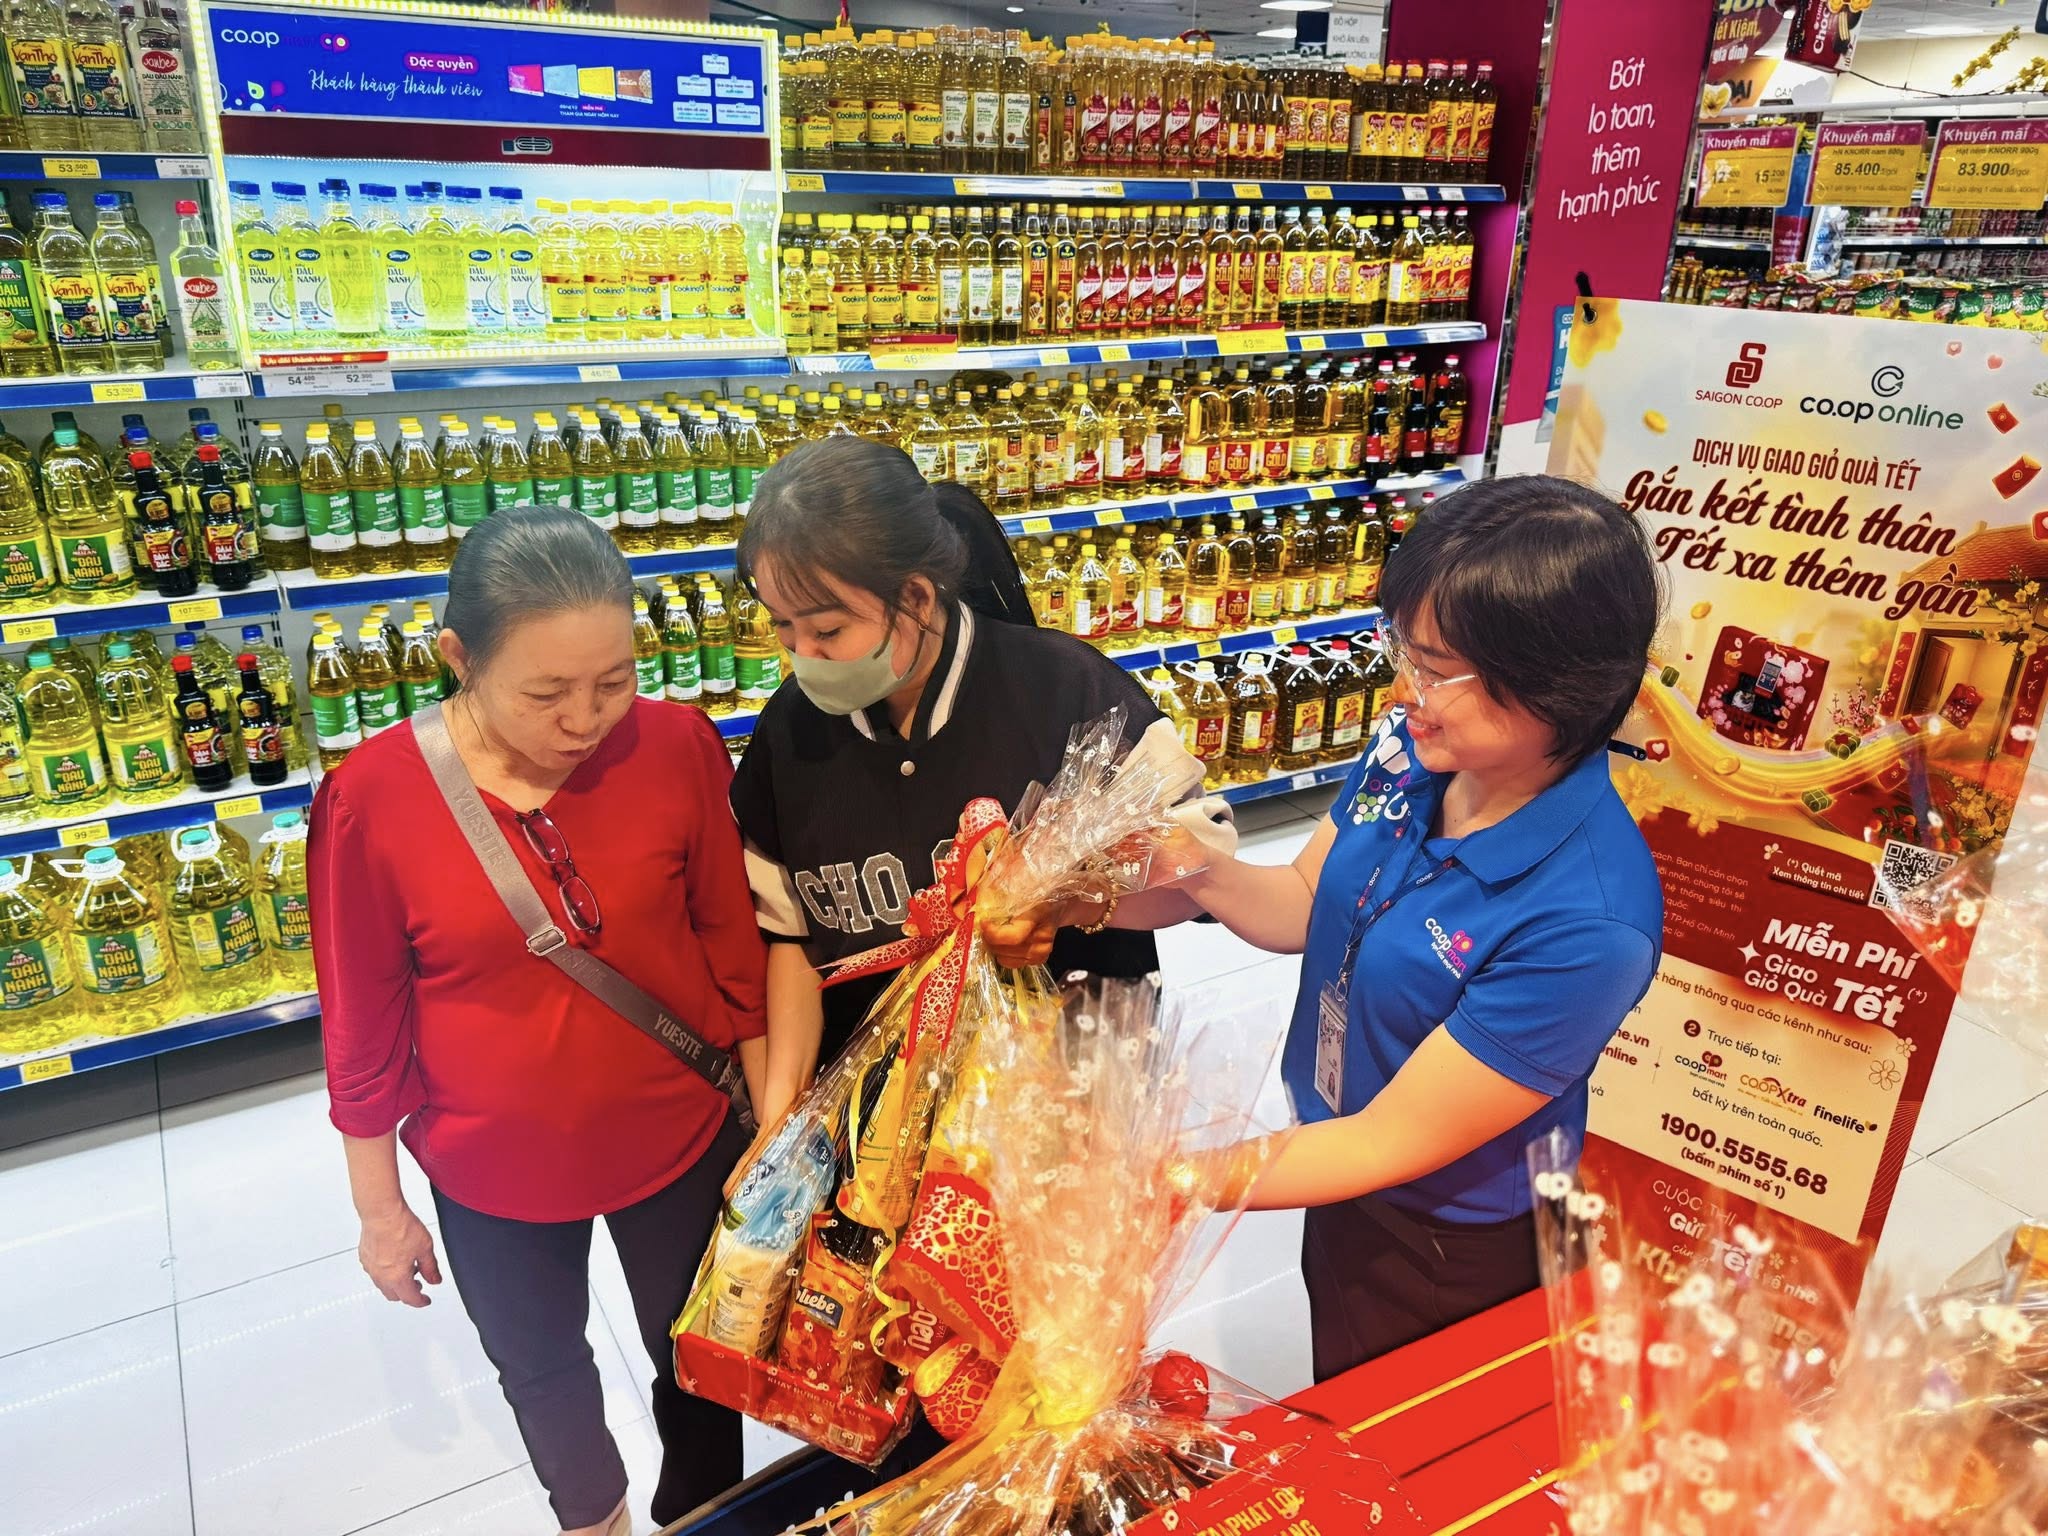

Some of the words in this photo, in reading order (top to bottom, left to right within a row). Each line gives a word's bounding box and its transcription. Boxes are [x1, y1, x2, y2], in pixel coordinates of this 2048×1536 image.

[221, 28, 280, 48] co.op
[409, 56, 434, 68] Đặc
[436, 56, 474, 71] quyền
[1609, 57, 1645, 90] Bớt
[308, 69, 355, 91] Khách
[360, 72, 400, 101] hàng
[399, 74, 447, 95] thành
[450, 80, 483, 97] viên
[1588, 103, 1606, 134] lo
[1610, 103, 1656, 130] toan,
[1944, 127, 1997, 143] Khuyến
[2001, 123, 2031, 140] mãi
[1707, 134, 1746, 150] Khuyến
[1749, 131, 1772, 146] mãi
[1822, 129, 1868, 145] Khuyến
[1871, 126, 1896, 142] mãi
[1592, 143, 1640, 174] thêm
[1558, 183, 1610, 222] hạnh
[1612, 175, 1660, 217] phúc
[1695, 389, 1743, 405] SAIGON
[1745, 395, 1783, 409] CO.OP
[1800, 396, 1874, 423] co.op
[1877, 404, 1964, 430] online
[1227, 455, 1249, 471] GOLD
[1266, 453, 1286, 467] GOLD
[1692, 438, 1735, 468] DỊCH
[1737, 443, 1762, 474] VỤ
[1762, 447, 1805, 475] GIAO
[1807, 448, 1838, 480] GIỎ
[1841, 456, 1878, 486] QUÀ
[1884, 458, 1922, 491] TẾT
[1619, 465, 1694, 514] Gắn
[1699, 478, 1771, 526] kết
[1769, 492, 1849, 540] tình
[1857, 504, 1957, 557] thân
[1655, 525, 1727, 572] Tết
[1722, 551, 1779, 581] xa
[1784, 548, 1888, 602] thêm
[1884, 562, 1981, 620] gần
[1228, 603, 1249, 615] GOLD
[1199, 731, 1221, 746] GOLD
[1772, 866, 1792, 879] Xem
[1793, 873, 1819, 888] thông
[1820, 881, 1832, 890] tin
[1833, 885, 1846, 895] chi
[1848, 888, 1865, 900] tiết
[1762, 918, 1852, 961] Miễn
[1855, 940, 1921, 981] Phí
[1764, 952, 1818, 985] Giao
[1661, 974, 1692, 993] hàng
[1694, 985, 1728, 1006] thông
[1731, 997, 1755, 1014] qua
[1757, 1007, 1781, 1024] các
[1784, 1014, 1814, 1035] kênh
[1817, 1027, 1842, 1043] như
[1844, 1038, 1872, 1055] sau:
[1743, 970, 1779, 993] Giỏ
[1783, 980, 1828, 1008] Quà
[1831, 978, 1905, 1028] Tết
[654, 1013, 704, 1061] YUESITE
[1707, 1029, 1733, 1047] Trực
[1735, 1039, 1759, 1058] tiếp
[1762, 1050, 1781, 1066] tại:
[1692, 1087, 1714, 1104] bất
[1715, 1096, 1729, 1111] kỳ
[1731, 1103, 1755, 1120] trên
[1758, 1114, 1786, 1132] toàn
[1789, 1126, 1823, 1148] quốc.
[1813, 1105, 1866, 1134] finelife
[1660, 1112, 1828, 1196] 1900.5555.68
[1681, 1146, 1716, 1170] (bấm
[1717, 1162, 1751, 1185] phím
[1753, 1176, 1774, 1192] số
[1775, 1185, 1786, 1199] 1)
[1653, 1180, 1703, 1211] CUỘC
